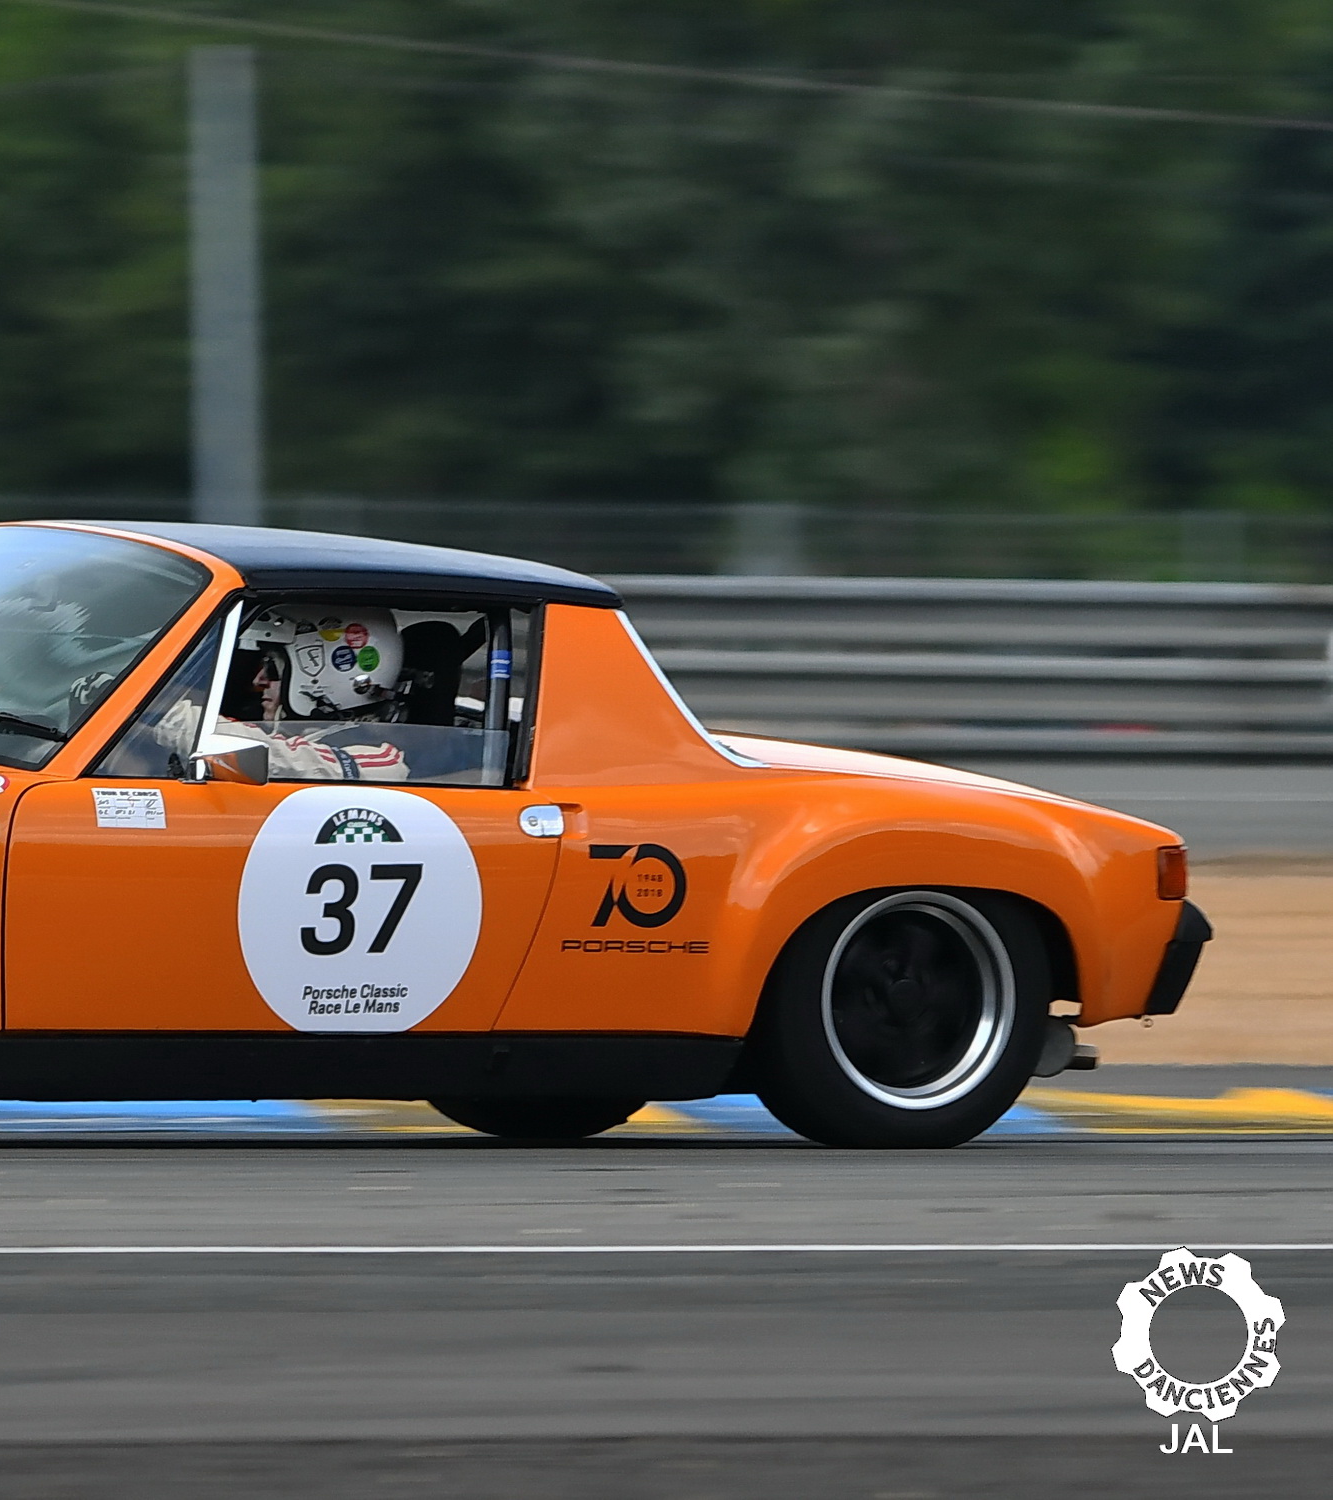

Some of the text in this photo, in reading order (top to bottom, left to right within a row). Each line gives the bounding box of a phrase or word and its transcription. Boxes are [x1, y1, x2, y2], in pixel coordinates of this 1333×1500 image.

[332, 809, 385, 827] LE MANS
[589, 843, 687, 928] 70
[637, 888, 664, 897] 2018
[300, 863, 423, 956] 37
[561, 939, 710, 954] PORSCHE
[302, 983, 409, 1001] Porsche Classic
[308, 999, 400, 1015] Race Le Mans
